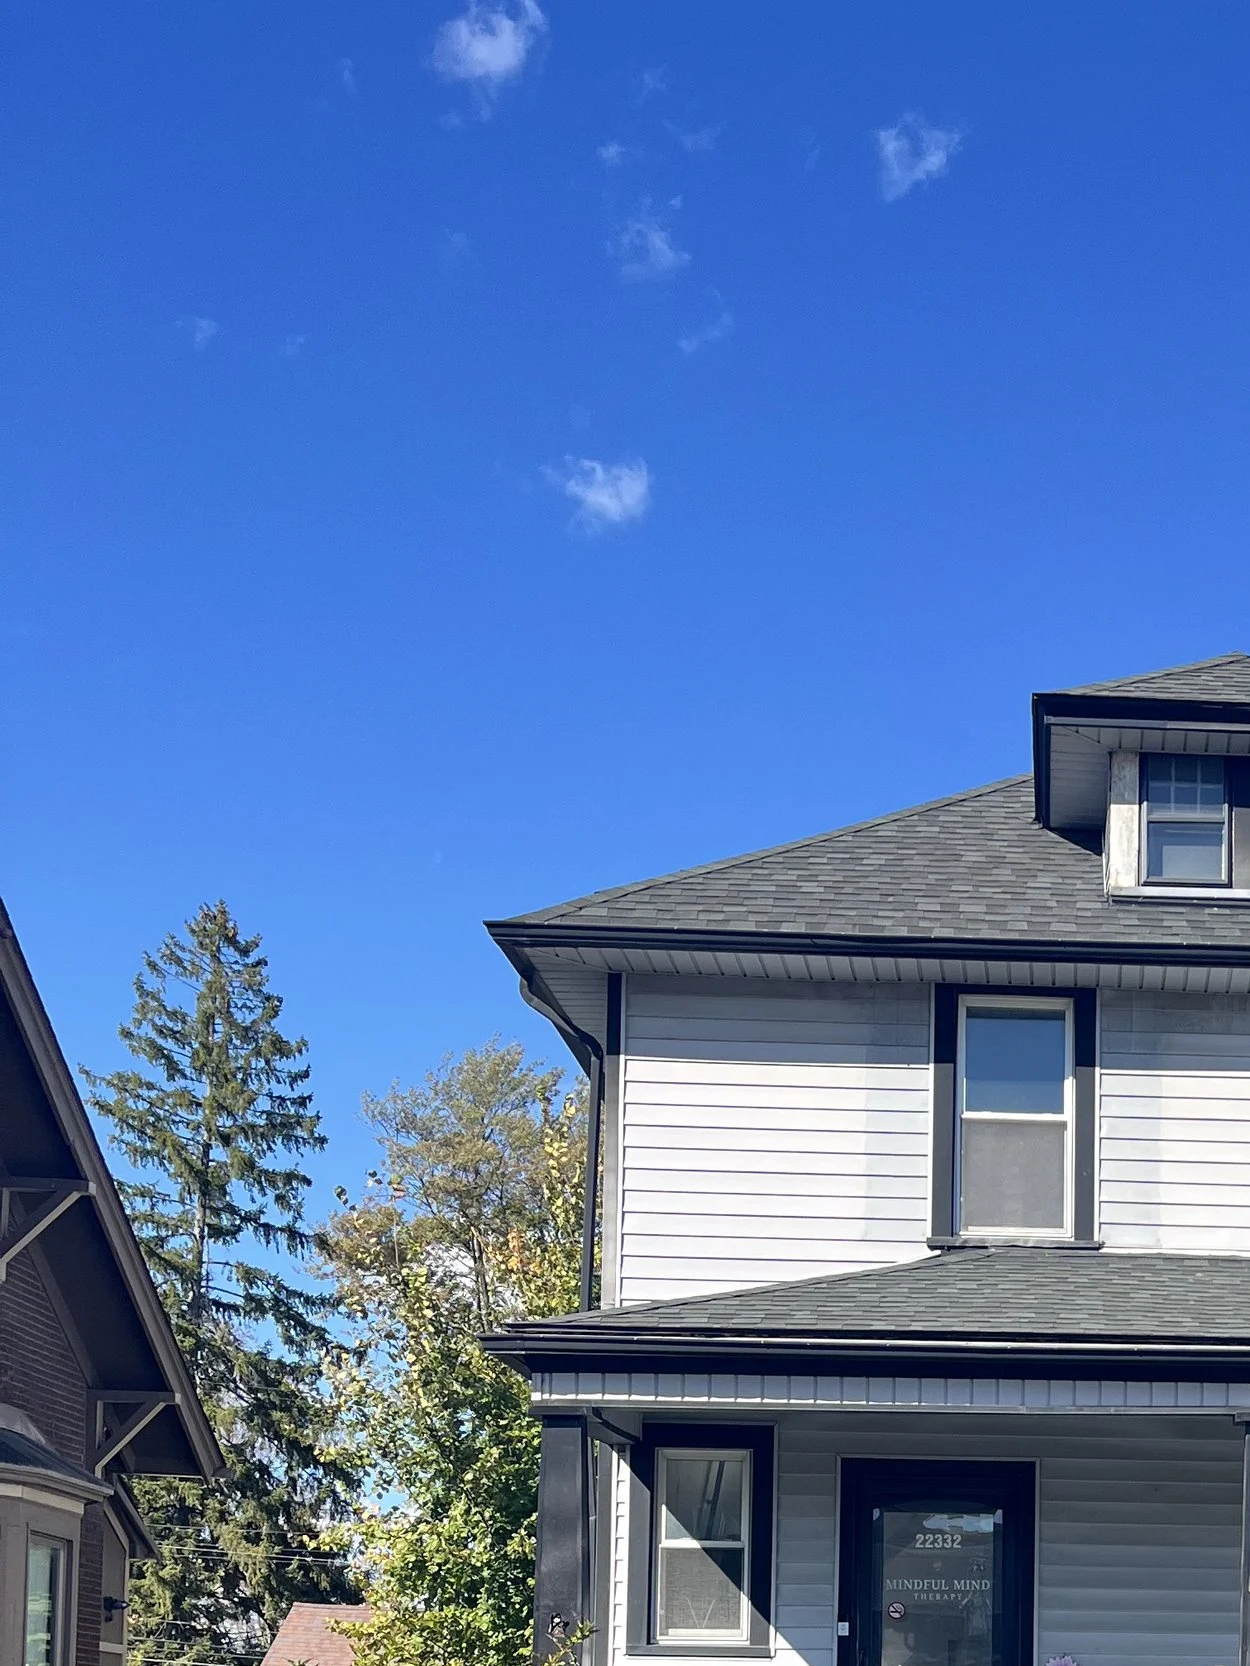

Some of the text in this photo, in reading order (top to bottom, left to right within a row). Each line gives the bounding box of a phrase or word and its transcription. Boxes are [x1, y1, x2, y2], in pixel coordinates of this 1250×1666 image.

[914, 1533, 962, 1549] 22332
[885, 1579, 991, 1591] MINDFUL MIND
[913, 1592, 963, 1601] THERAPY
